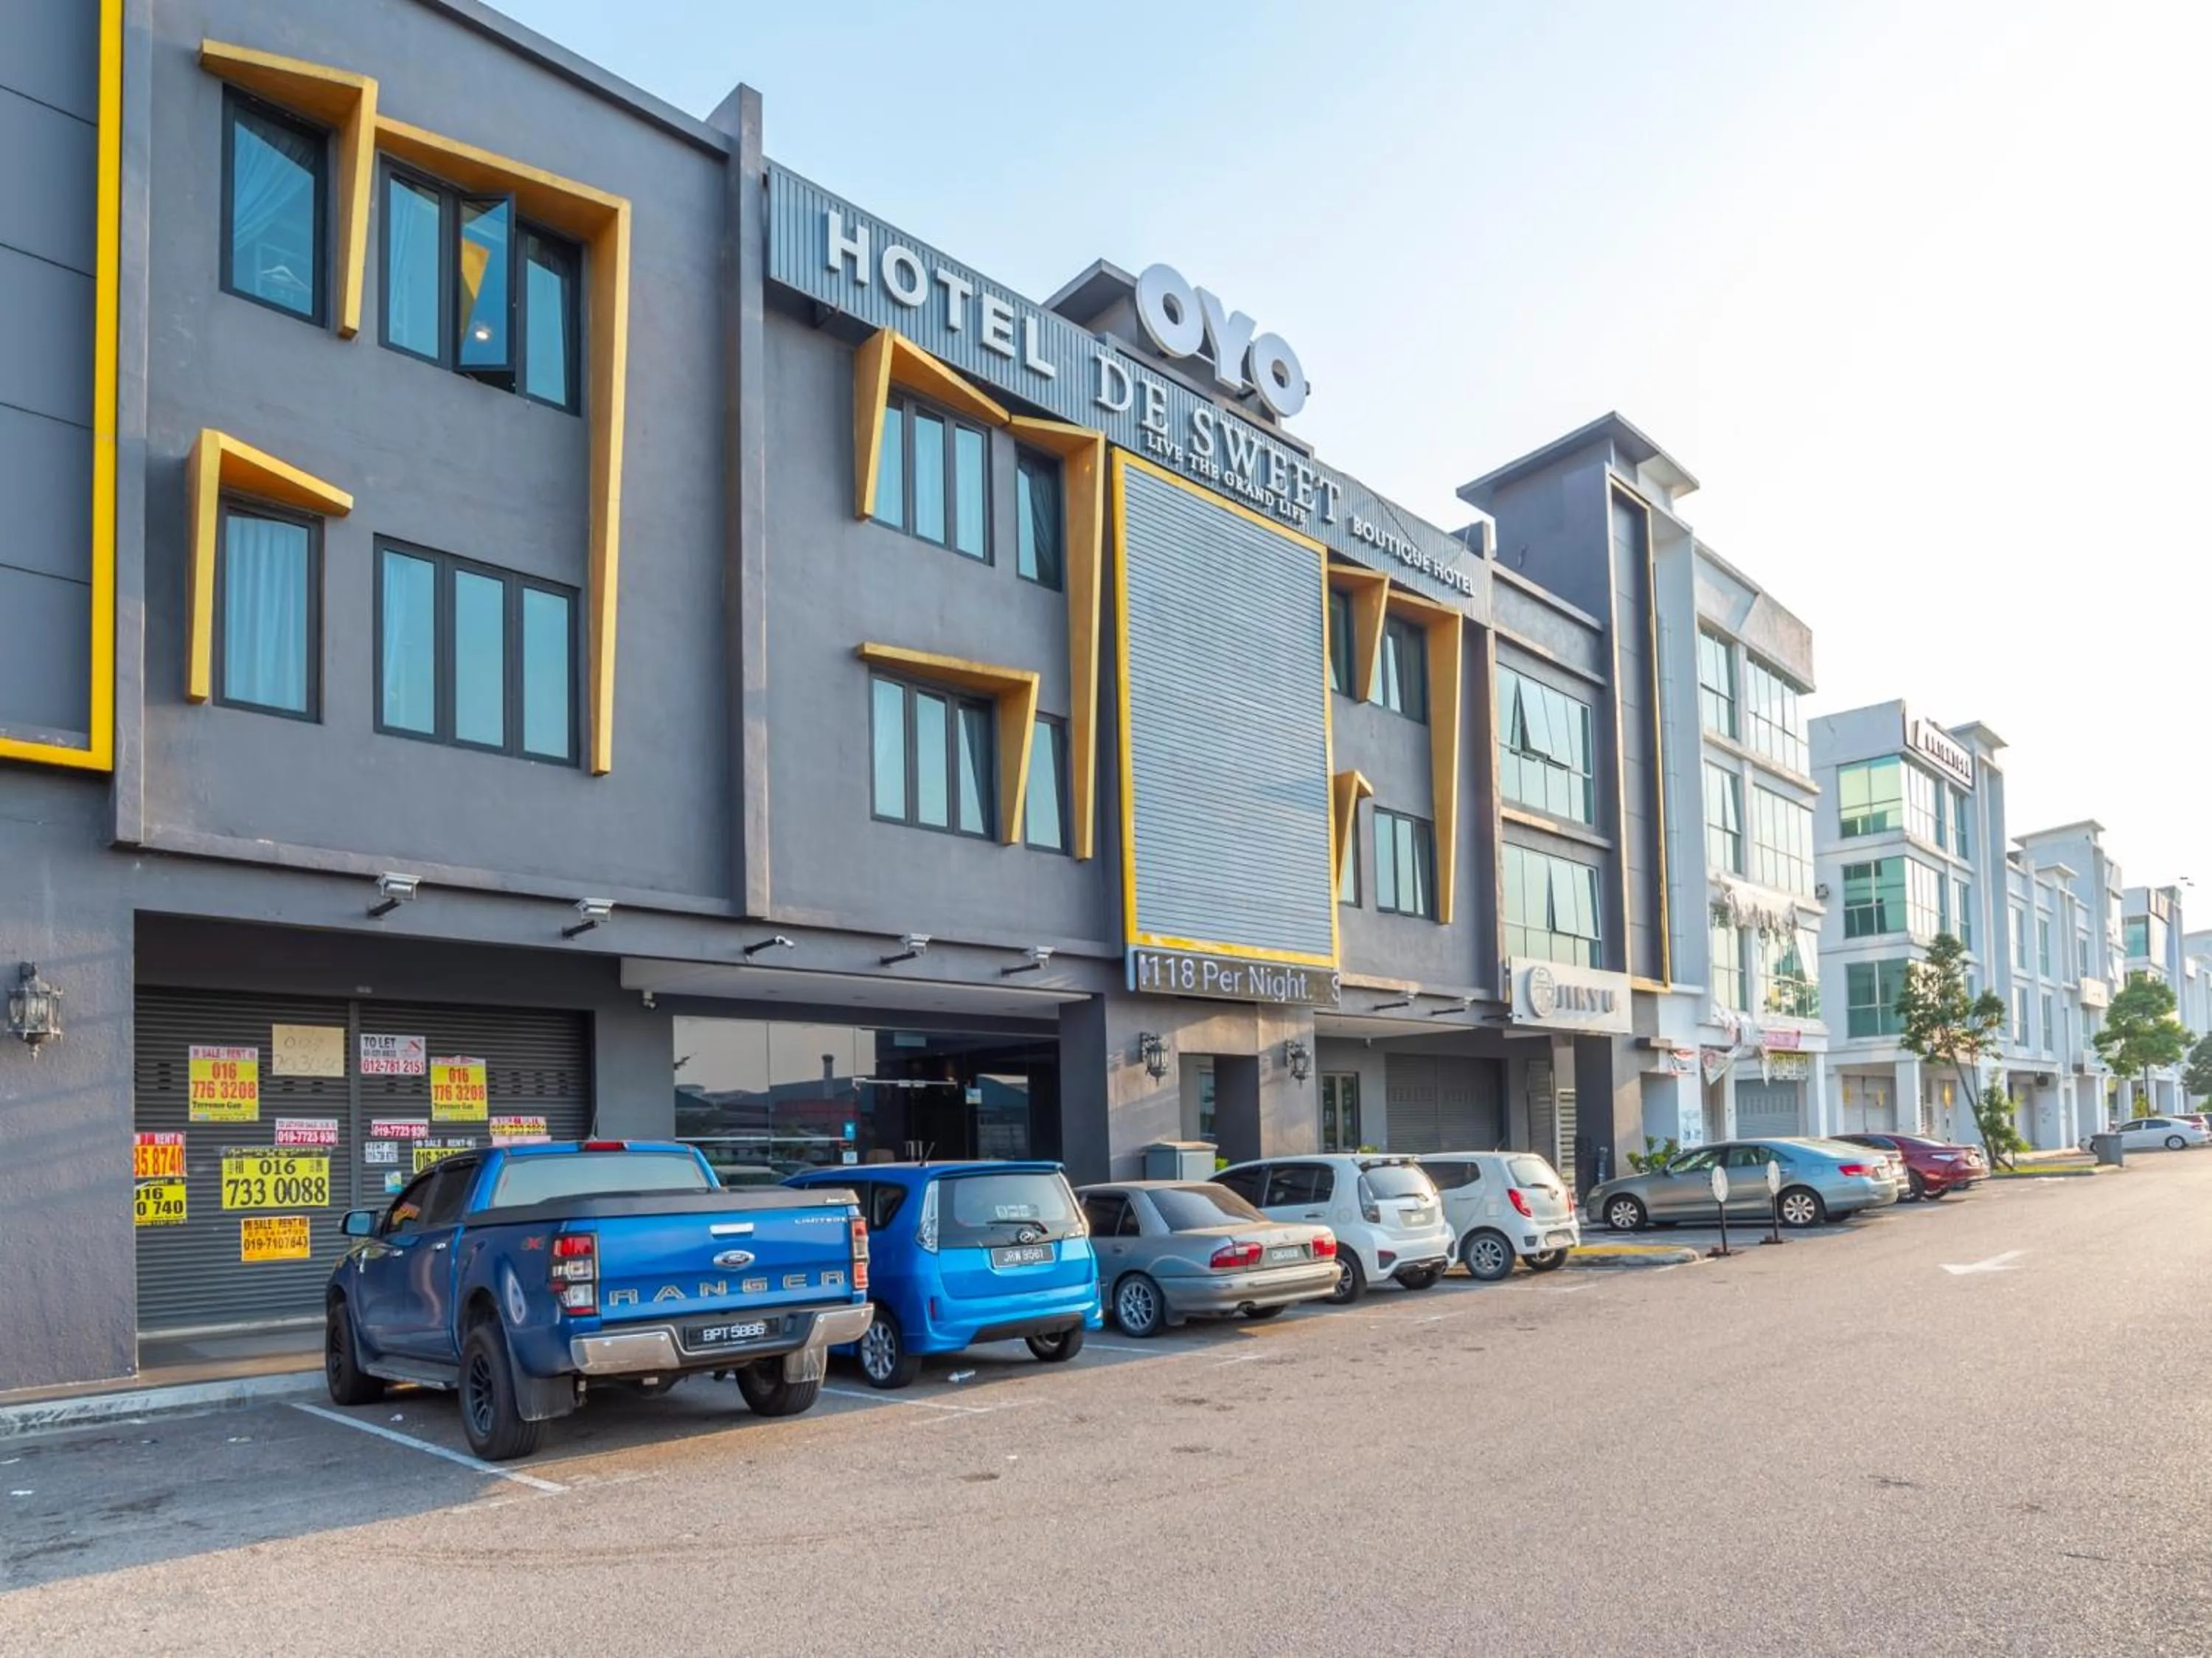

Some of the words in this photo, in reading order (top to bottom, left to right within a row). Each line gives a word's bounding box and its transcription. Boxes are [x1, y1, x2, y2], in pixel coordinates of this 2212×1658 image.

[827, 209, 1055, 380] HOTEL
[1135, 263, 1307, 418] OYO
[1096, 353, 1169, 437] DE
[1193, 407, 1340, 524] SWEET
[1147, 431, 1183, 463] LIVE
[1189, 451, 1220, 480] THE
[1225, 469, 1275, 507] GRAND
[1279, 499, 1308, 526] LIFE
[1352, 515, 1431, 572] BOUTIQUE
[1433, 559, 1475, 597] HOTEL
[1203, 960, 1242, 992] Per
[1248, 965, 1312, 1002] Night.
[364, 1037, 377, 1048] TO
[378, 1037, 396, 1048] LET
[212, 1061, 237, 1080] 016
[449, 1067, 470, 1083] 016
[192, 1081, 215, 1098] 776
[220, 1081, 256, 1099] 3208
[433, 1085, 452, 1101] 776
[260, 1159, 296, 1176] 016
[226, 1178, 266, 1206] 733
[274, 1176, 326, 1204] 0088
[153, 1199, 184, 1215] 740
[608, 1270, 845, 1307] RANGER
[703, 1327, 728, 1342] BPT
